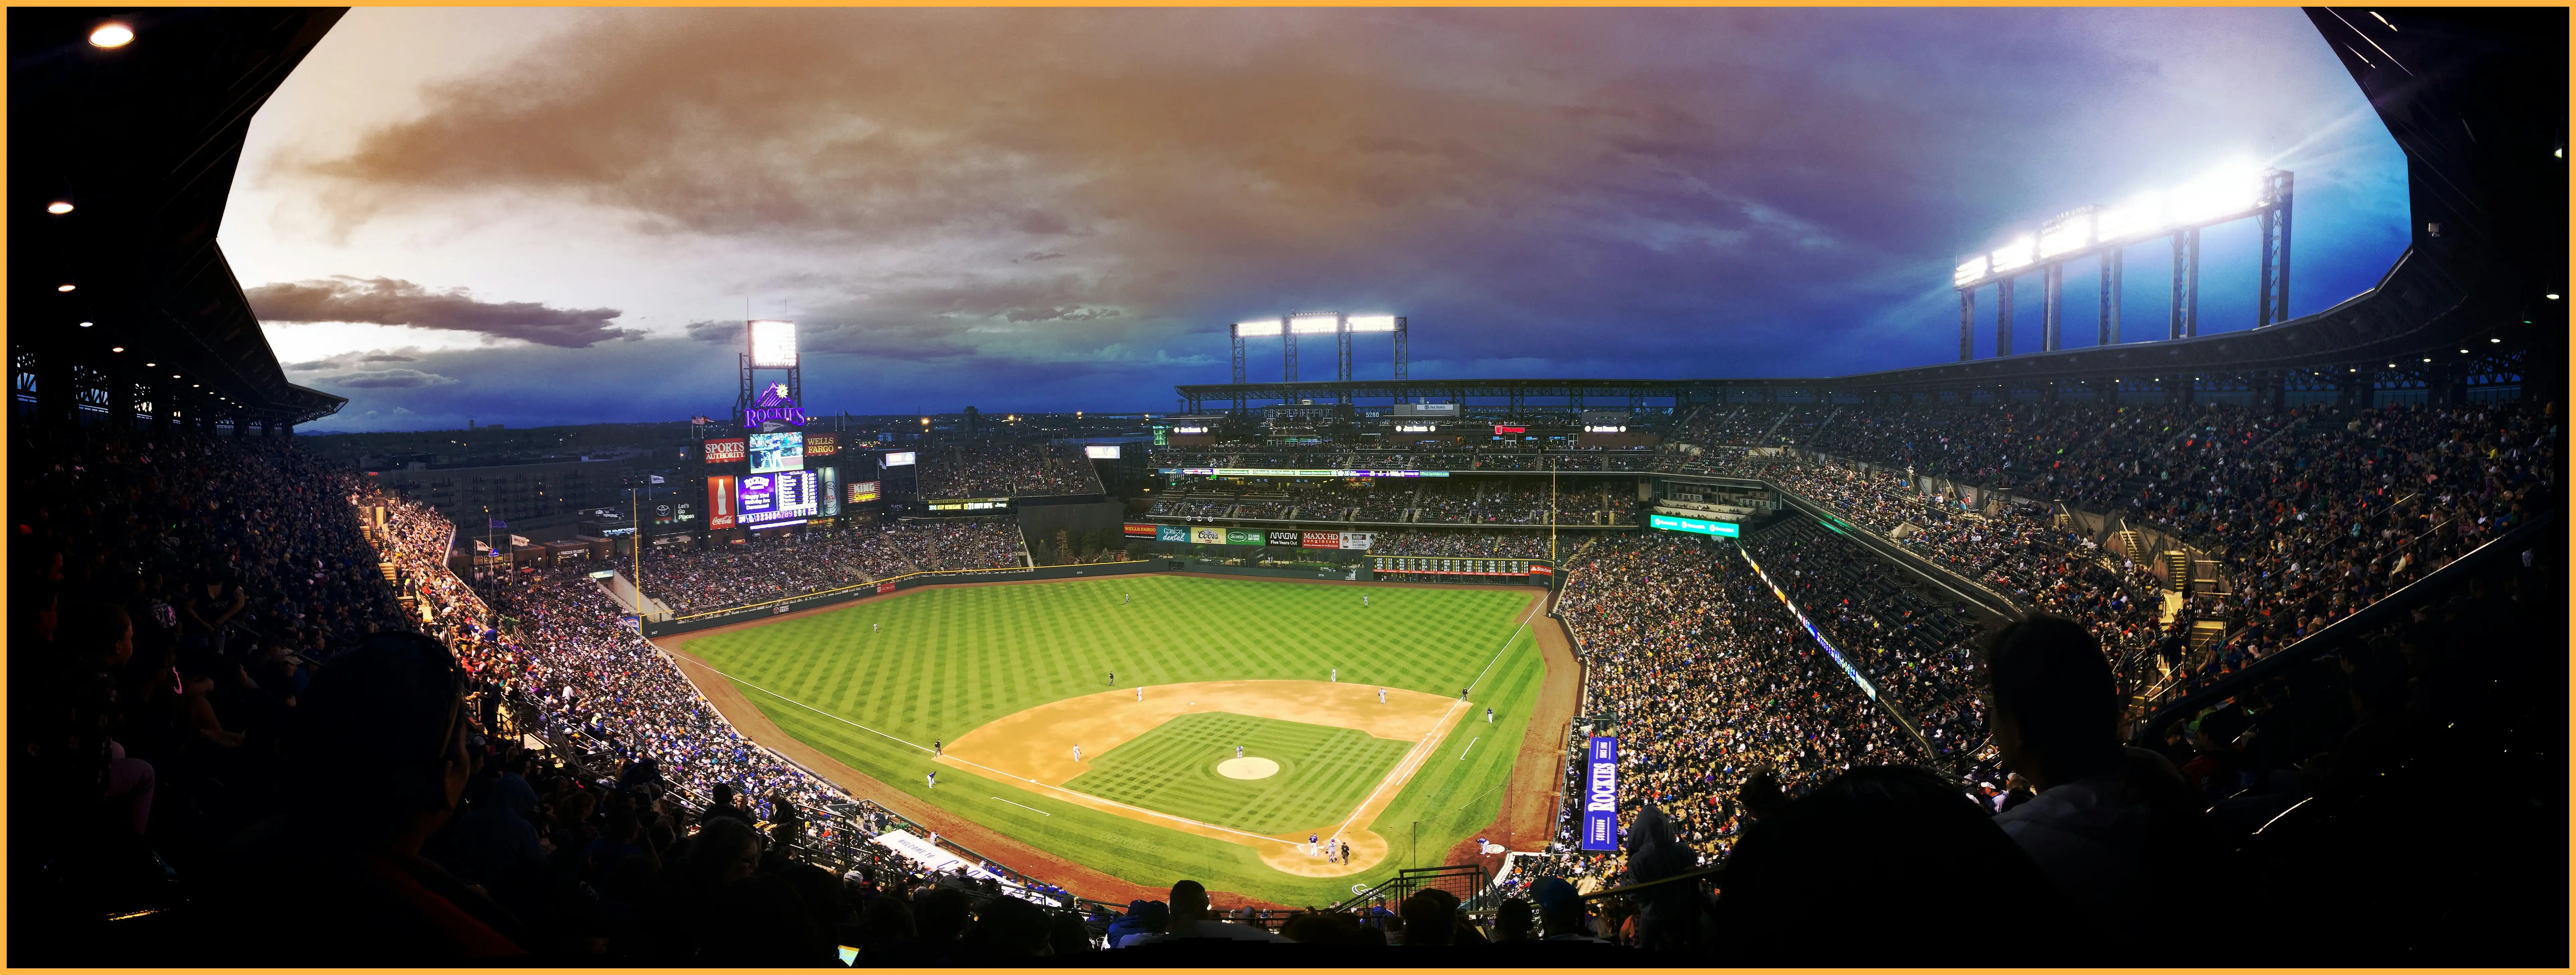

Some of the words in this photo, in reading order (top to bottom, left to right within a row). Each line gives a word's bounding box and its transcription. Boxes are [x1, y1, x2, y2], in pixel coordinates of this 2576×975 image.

[744, 407, 805, 428] ROCKIES
[1262, 409, 1279, 417] THE
[1286, 409, 1329, 417] ROOFTOP
[705, 442, 744, 453] SPORTS
[854, 483, 875, 493] KING
[712, 515, 732, 525] Coca-Cola
[1163, 533, 1185, 541] dental
[1198, 531, 1218, 539] Coors
[1599, 750, 1607, 758] SINCE
[1588, 763, 1615, 812] ROCKIES
[1595, 819, 1606, 841] COLORADO
[898, 839, 926, 854] WELCOME
[925, 850, 935, 858] TO
